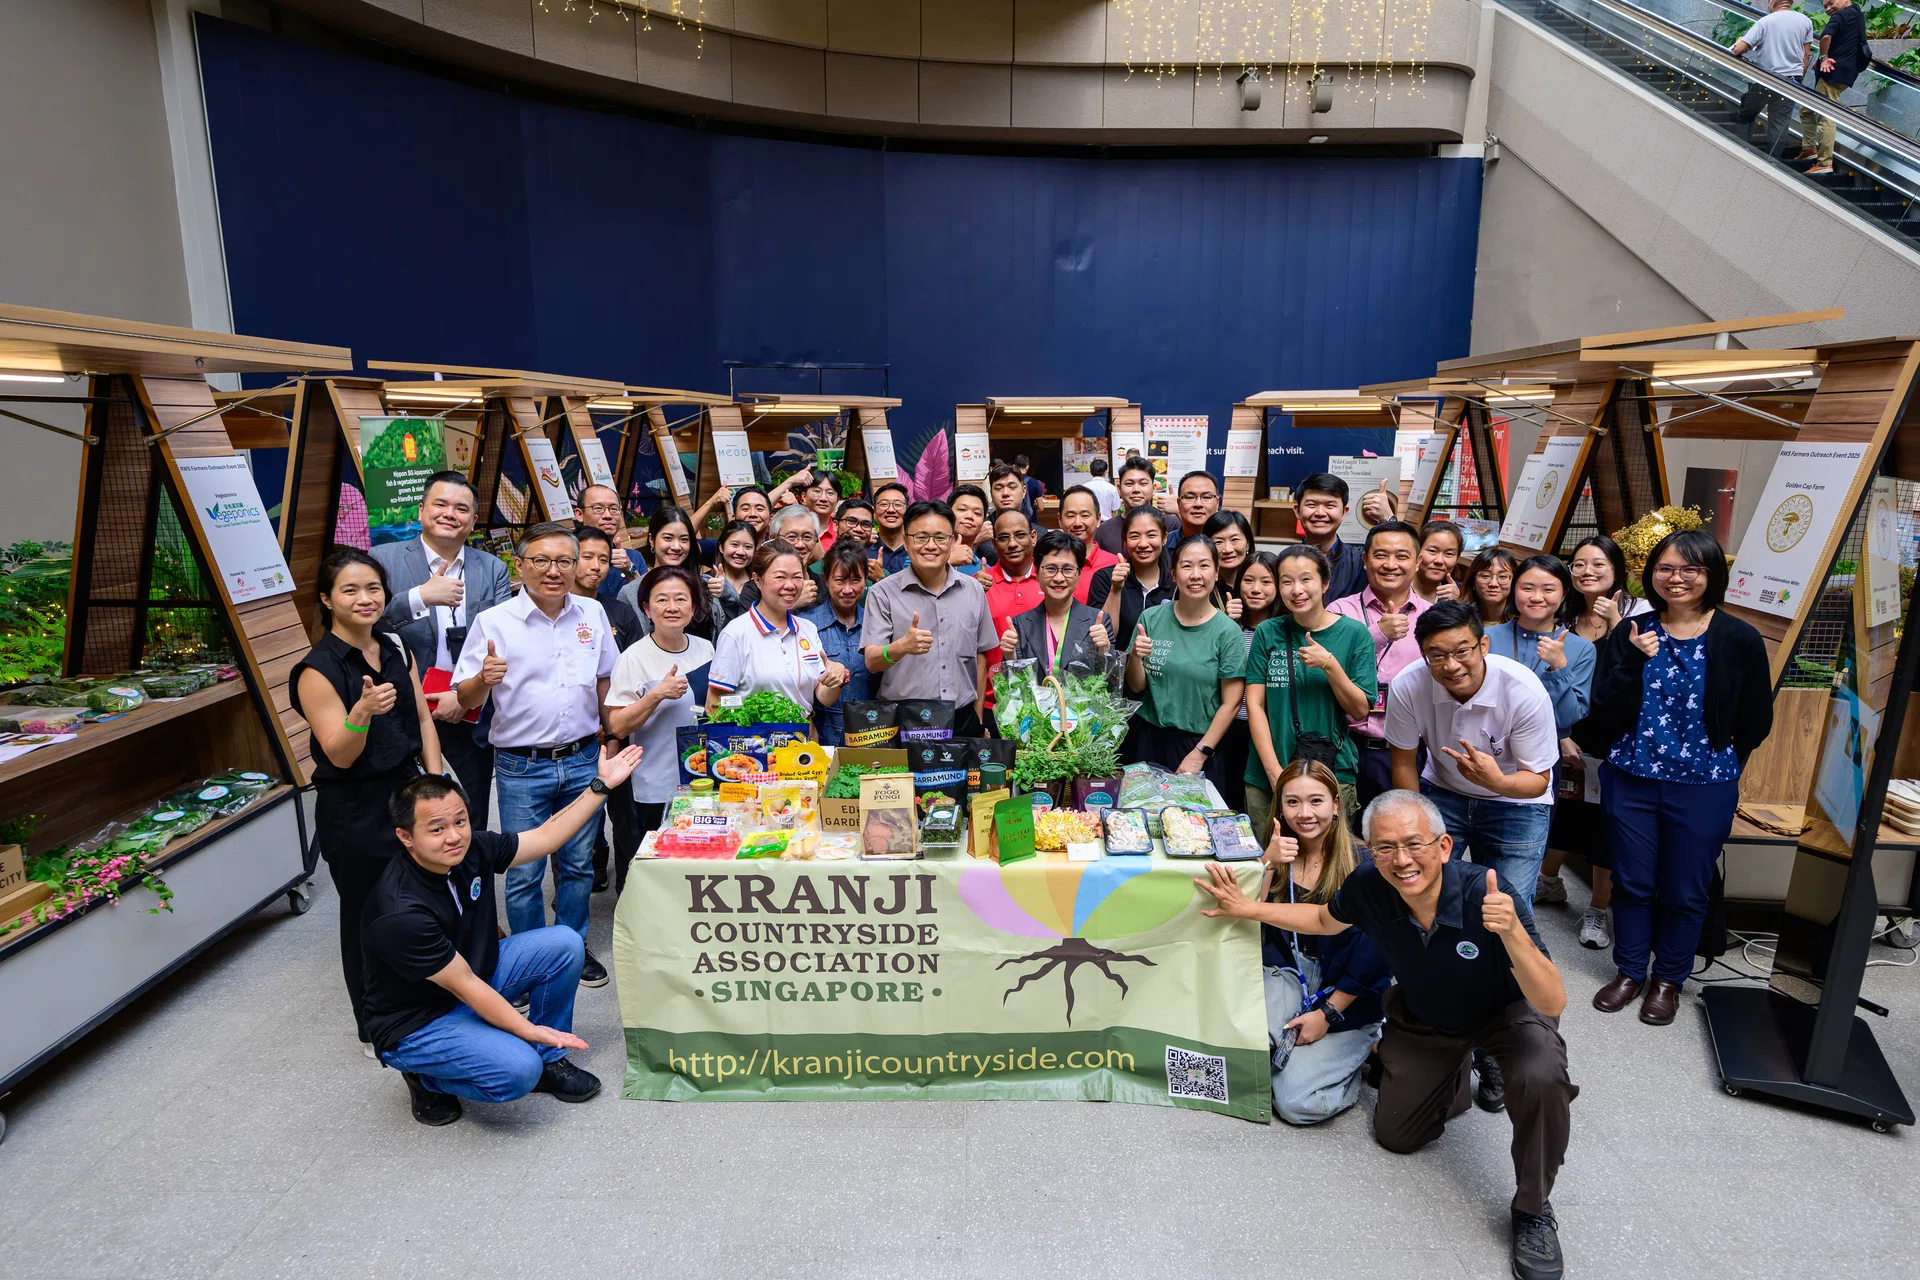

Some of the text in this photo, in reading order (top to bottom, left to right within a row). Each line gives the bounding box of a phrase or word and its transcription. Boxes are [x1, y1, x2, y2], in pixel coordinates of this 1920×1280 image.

[1286, 446, 1304, 454] visit.
[729, 742, 748, 750] Fish
[0, 870, 22, 888] CITY
[685, 874, 937, 915] KRANJI
[690, 922, 939, 945] COUNTRYSIDE
[692, 951, 939, 974] ASSOCIATION
[711, 980, 924, 1003] SINGAPORE
[669, 1047, 1134, 1082] http://kranjicountryside.com
